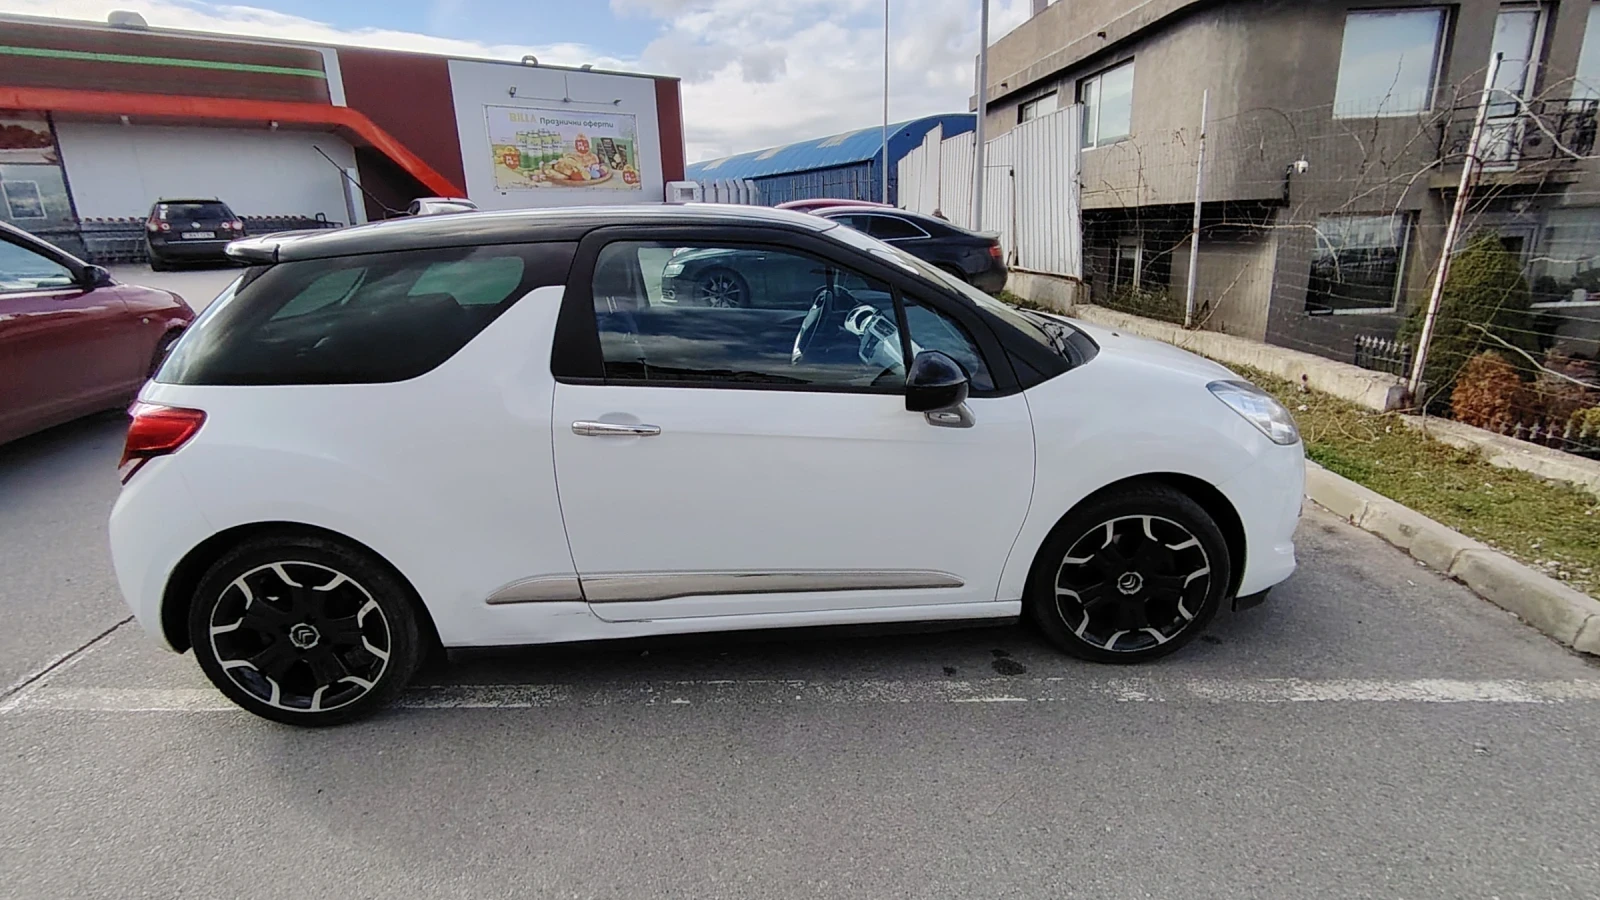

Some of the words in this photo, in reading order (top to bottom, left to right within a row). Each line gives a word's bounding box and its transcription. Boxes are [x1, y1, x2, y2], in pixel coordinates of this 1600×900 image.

[510, 112, 537, 123] BILLA
[540, 117, 582, 127] Празнички
[583, 120, 614, 128] оферти
